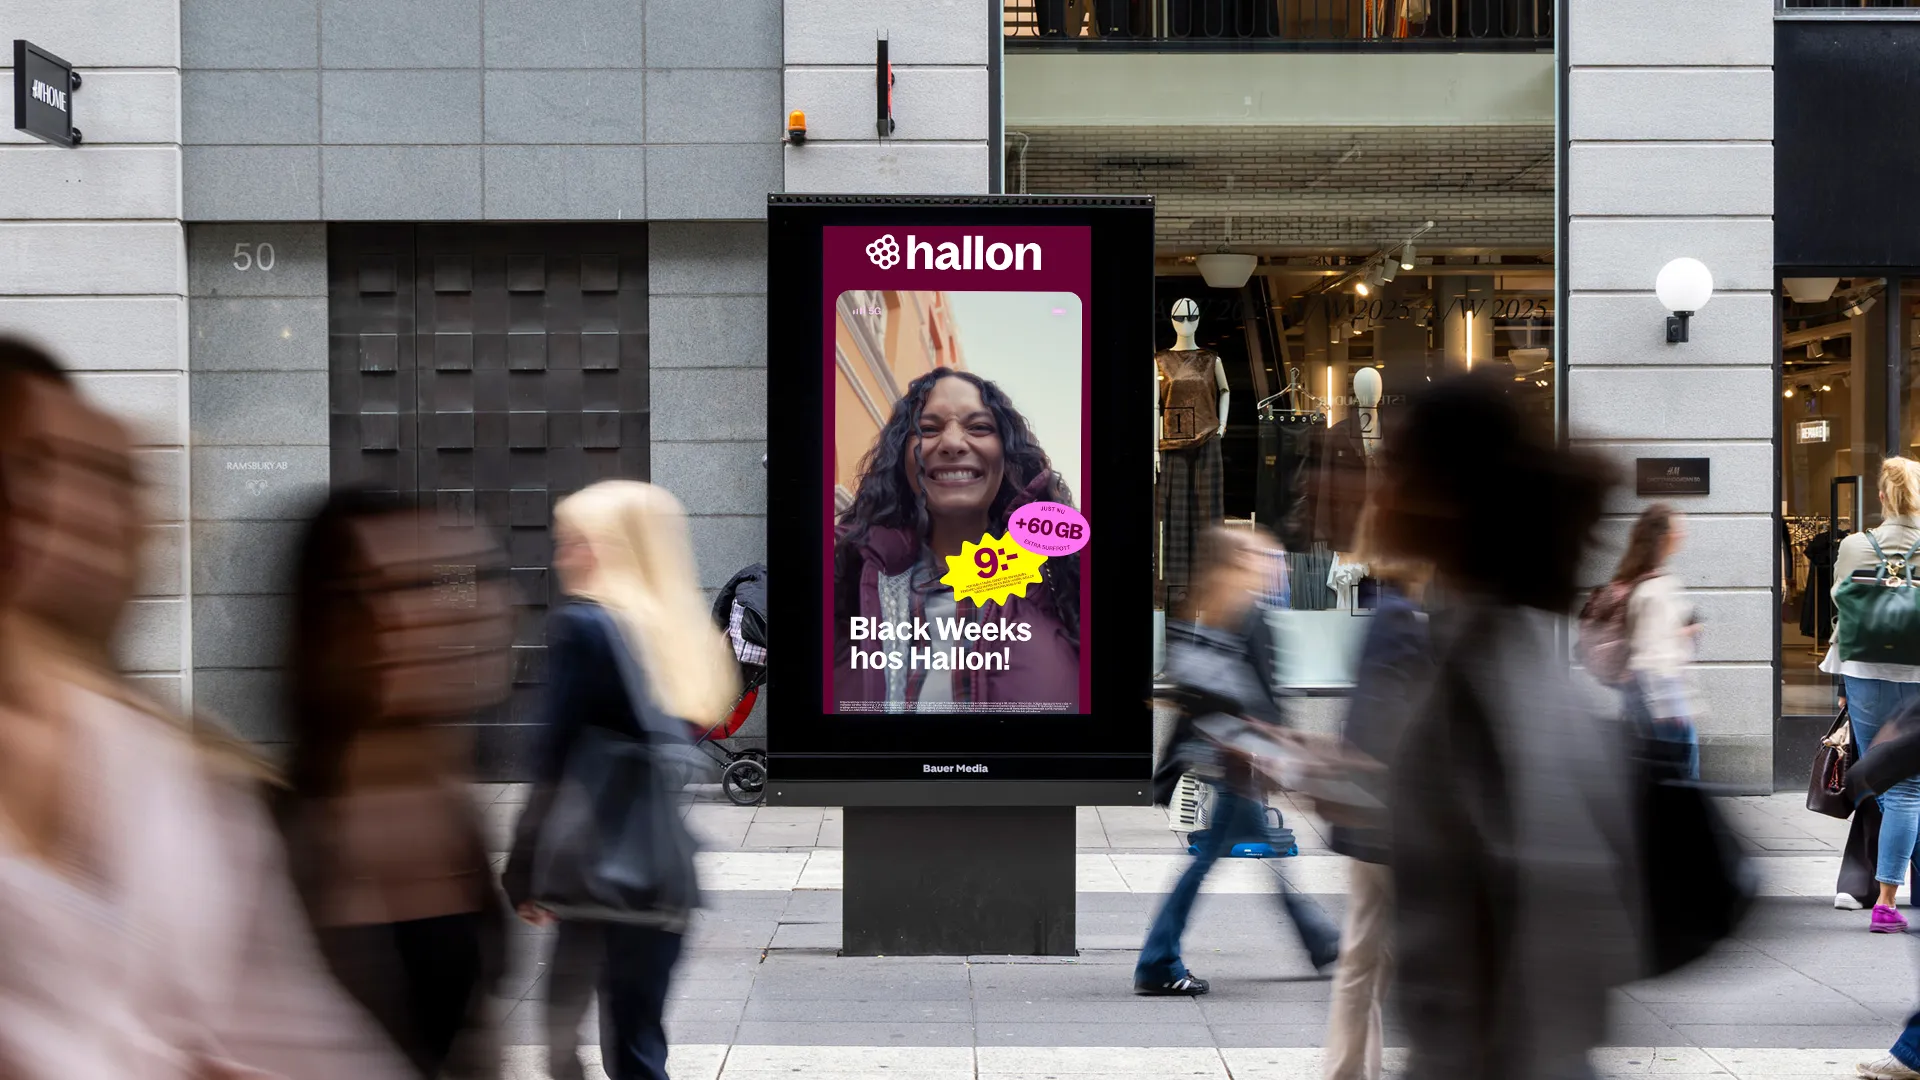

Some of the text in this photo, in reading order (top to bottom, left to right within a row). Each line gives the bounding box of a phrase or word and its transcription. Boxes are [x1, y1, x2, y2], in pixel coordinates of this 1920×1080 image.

[233, 242, 275, 271] 50
[906, 234, 1042, 271] hallon
[868, 306, 882, 315] 5G
[1354, 298, 1412, 321] 2025
[1424, 298, 1549, 322] A/W 2025
[1171, 412, 1184, 434] 1
[1359, 412, 1373, 433] 2
[226, 461, 288, 470] RAMSBURY AB
[1015, 517, 1083, 540] +60 GB
[1023, 539, 1071, 552] EXTRA SURFPOTT
[849, 616, 1032, 642] Black Weeks
[850, 646, 1010, 671] hos Hallon!
[923, 763, 989, 773] Bauer Media
